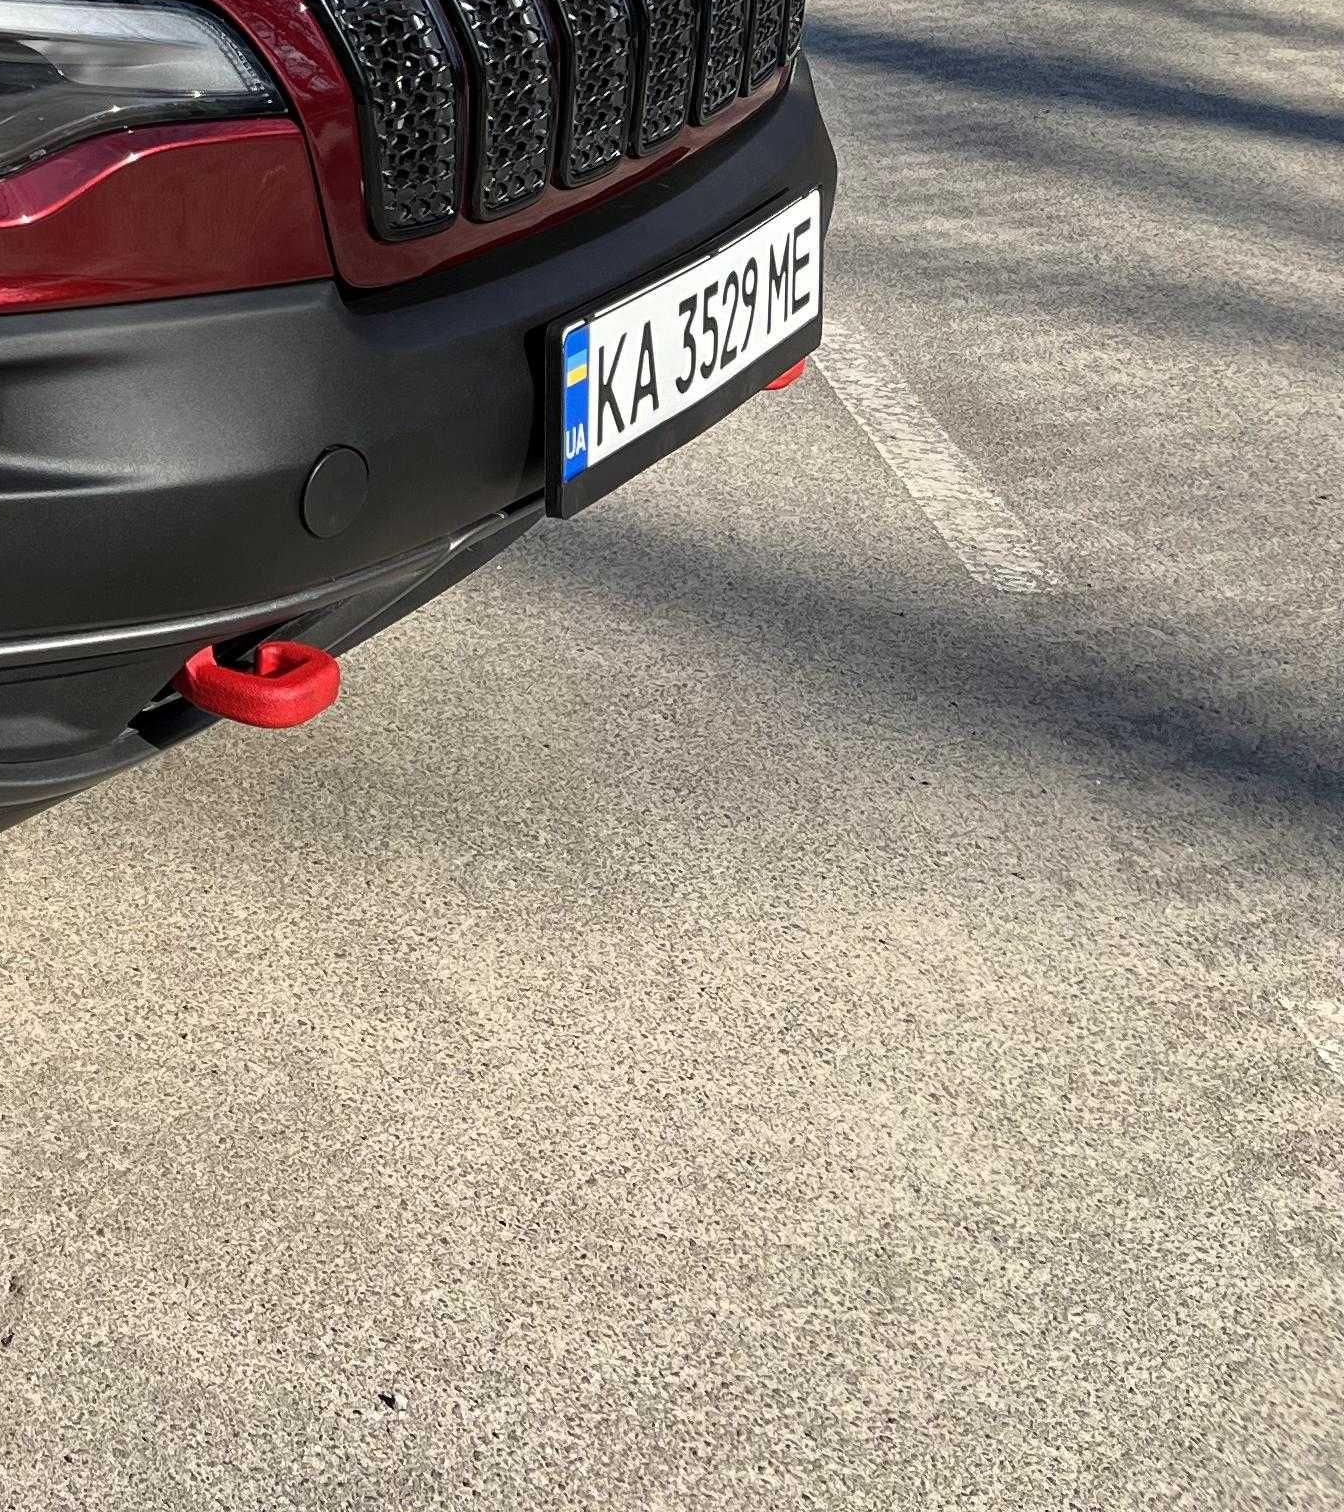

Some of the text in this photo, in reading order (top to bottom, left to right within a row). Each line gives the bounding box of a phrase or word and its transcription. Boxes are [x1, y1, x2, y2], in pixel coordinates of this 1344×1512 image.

[596, 216, 812, 446] KA 3529 ME
[564, 422, 587, 460] UA
